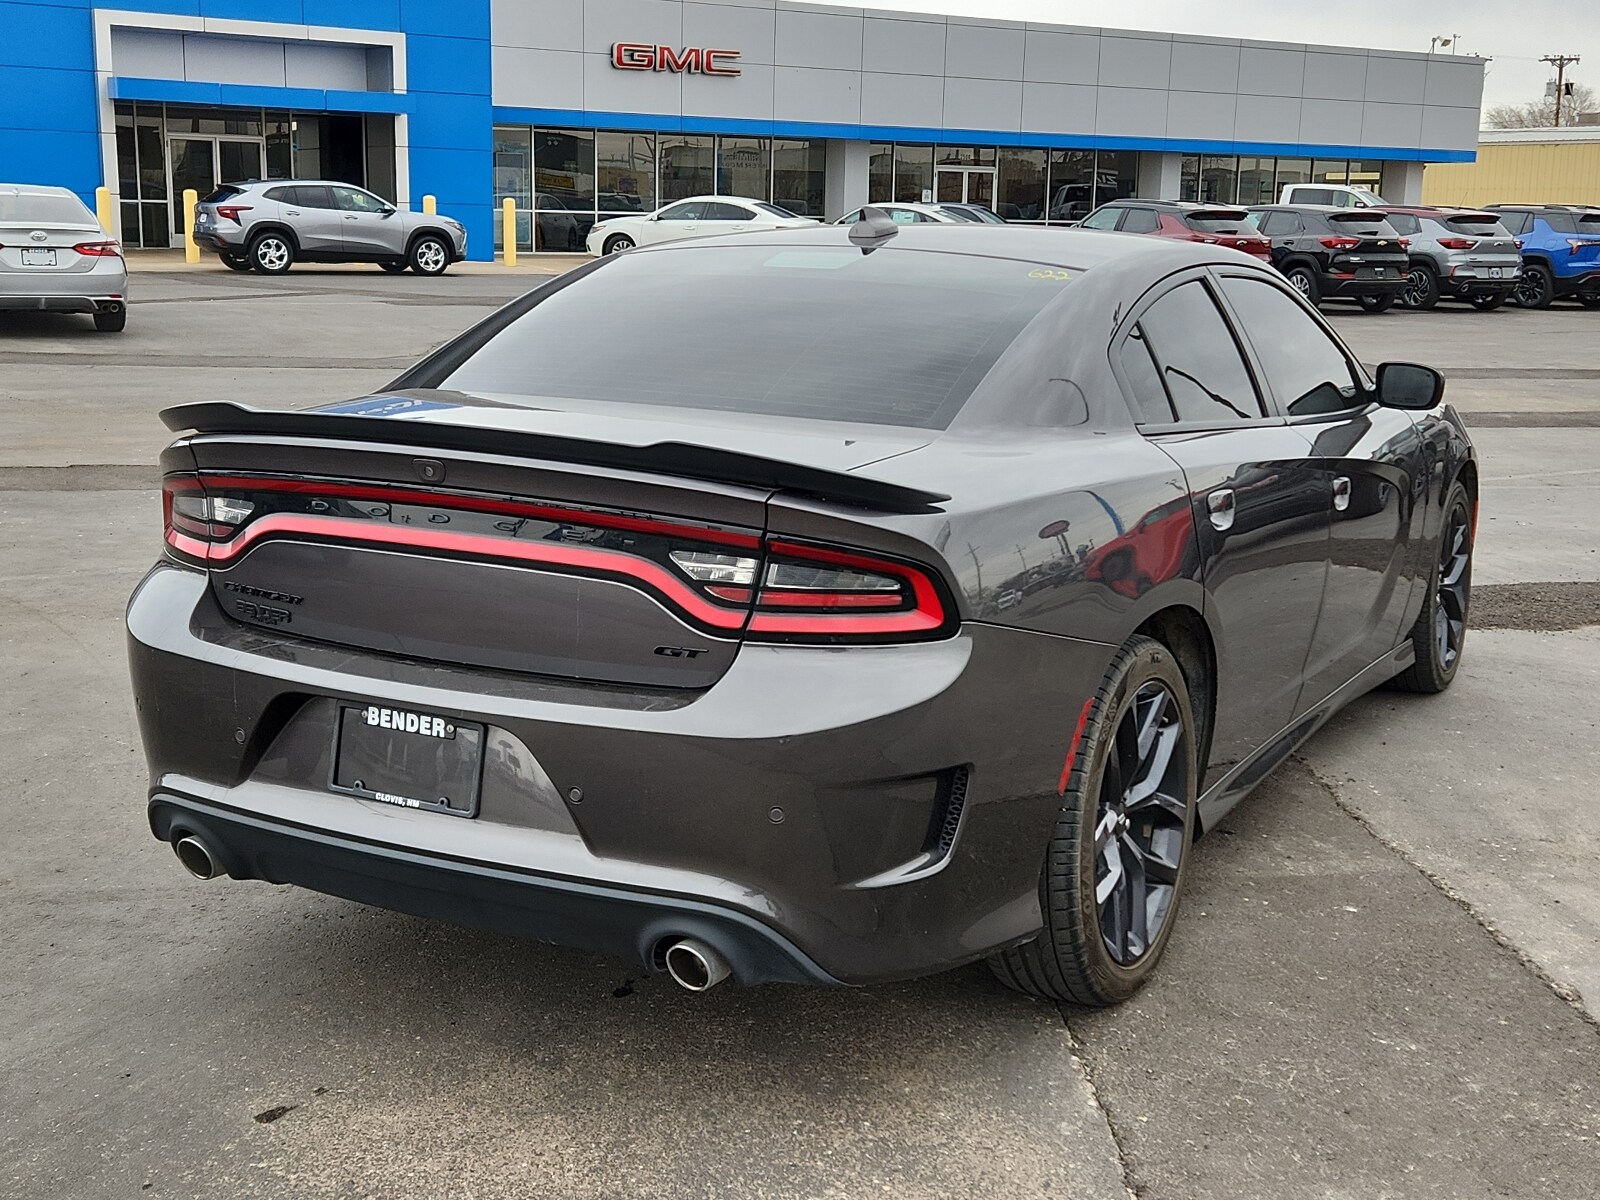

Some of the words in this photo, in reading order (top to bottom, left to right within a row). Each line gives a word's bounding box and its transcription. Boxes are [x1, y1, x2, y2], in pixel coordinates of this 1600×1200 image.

[611, 42, 741, 77] GMC
[311, 499, 586, 541] DODGE
[653, 645, 709, 659] GT
[367, 706, 445, 738] BENDER
[375, 792, 406, 807] CLOVIS,
[406, 799, 420, 808] NM
